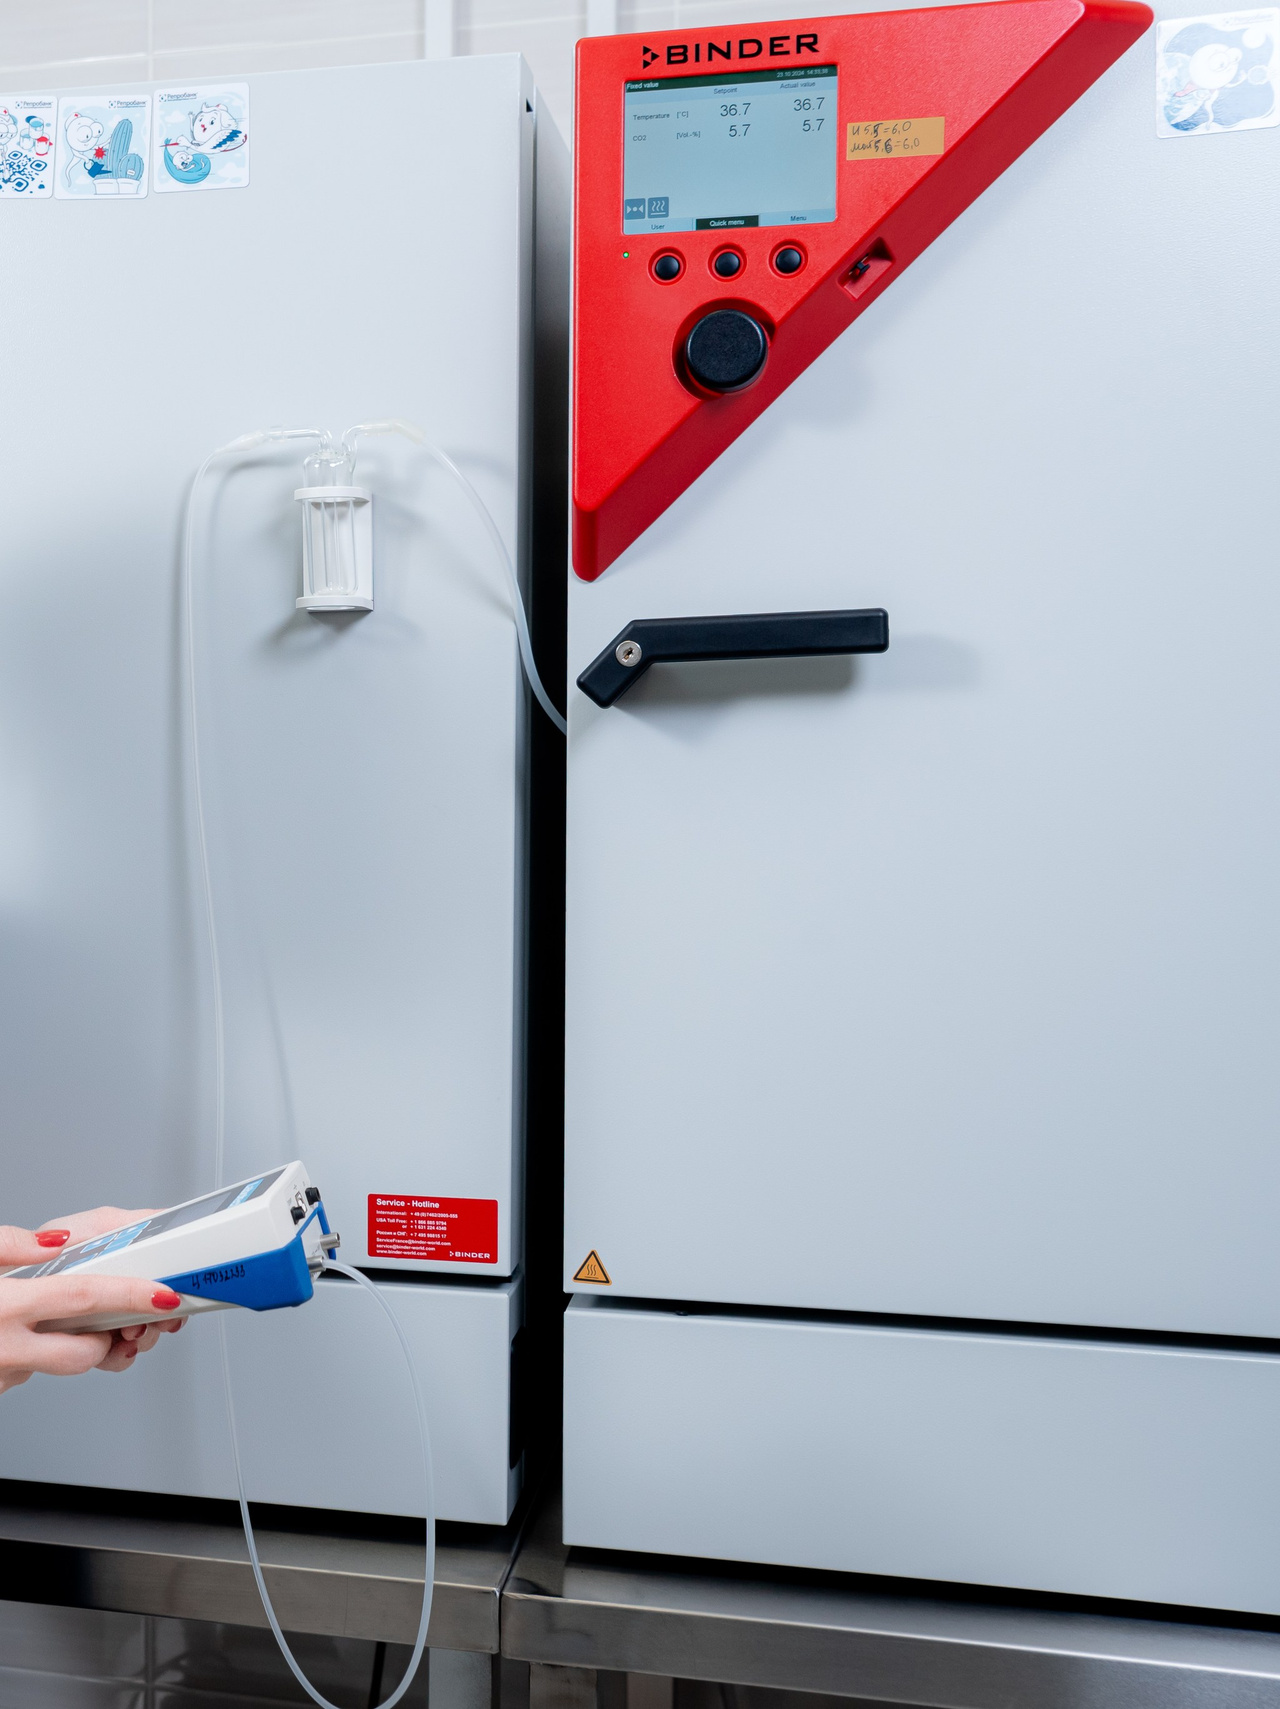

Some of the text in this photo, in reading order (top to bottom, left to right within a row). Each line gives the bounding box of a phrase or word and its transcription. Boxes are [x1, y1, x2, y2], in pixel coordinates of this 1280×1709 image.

[666, 33, 820, 65] BINDER
[626, 81, 659, 90] Fixed value
[779, 80, 816, 90] Actual value
[167, 92, 197, 100] Репробанк
[713, 87, 738, 95] Setpoint
[793, 97, 825, 112] 36.7
[633, 112, 670, 122] Temperature
[720, 103, 751, 117] 36.7
[802, 118, 825, 132] 5.7
[633, 134, 646, 142] CO2
[728, 124, 751, 138] 5.7
[709, 219, 727, 227] Quick
[376, 1198, 405, 1207] Service
[412, 1200, 440, 1209] Hotline
[376, 1237, 451, 1246] ServiceFrance@binder-world.com
[455, 1251, 490, 1259] BINDER
